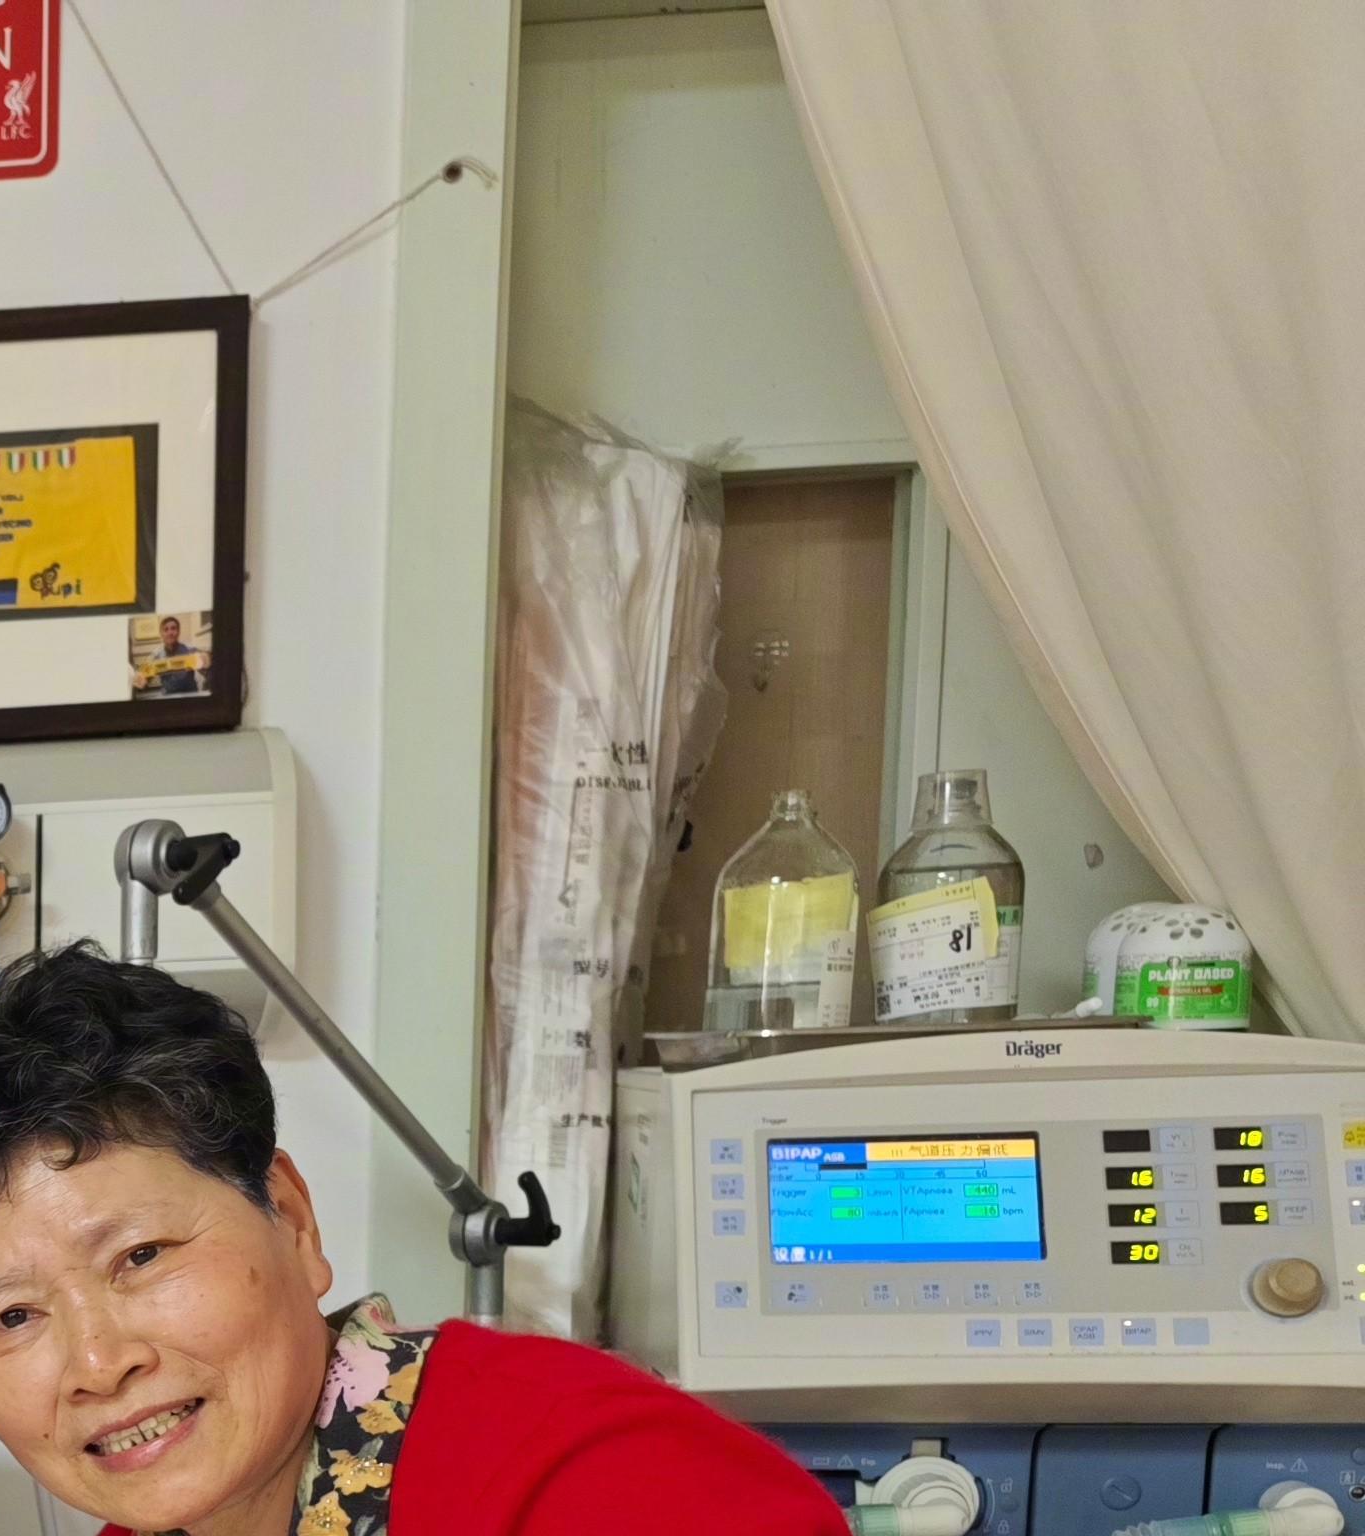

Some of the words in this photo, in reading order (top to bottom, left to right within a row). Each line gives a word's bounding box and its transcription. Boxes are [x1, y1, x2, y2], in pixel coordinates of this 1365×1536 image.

[1148, 968, 1191, 982] PLANT
[1005, 1040, 1063, 1059] Dräger
[772, 1147, 823, 1161] BIPAP
[1131, 1170, 1154, 1186] 16
[1243, 1168, 1266, 1184] 16
[1133, 1207, 1157, 1224] 12
[1254, 1205, 1268, 1222] 5
[1129, 1244, 1159, 1261] 30
